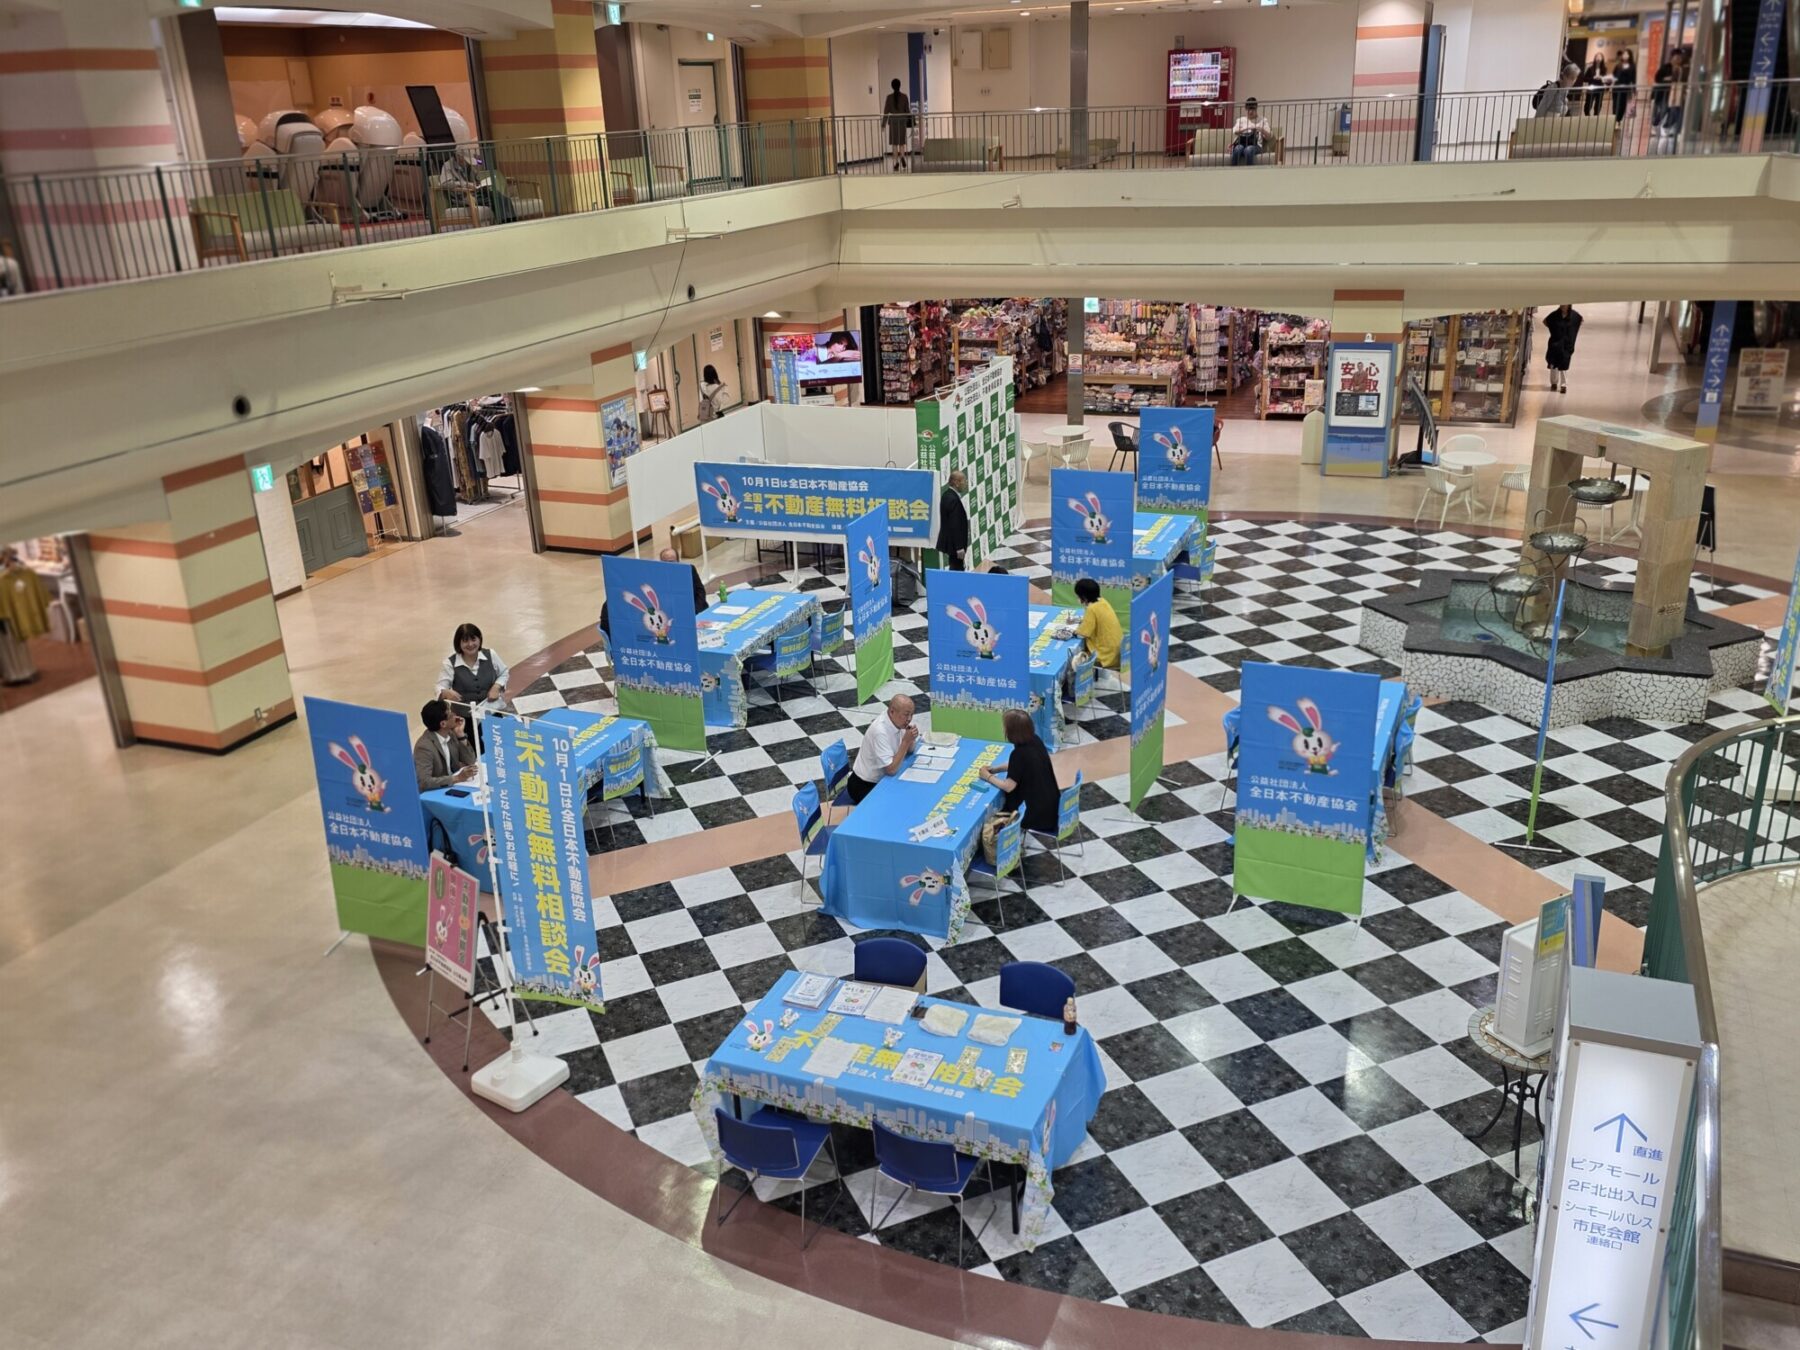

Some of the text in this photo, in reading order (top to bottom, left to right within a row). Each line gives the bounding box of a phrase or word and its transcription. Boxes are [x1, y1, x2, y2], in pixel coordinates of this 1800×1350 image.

[1341, 362, 1379, 376] 安心
[742, 476, 869, 492] 10月1日は全日本不動産協会
[1060, 554, 1125, 568] 全日本不動産協会
[621, 655, 692, 673] 全日本不動産協会
[936, 662, 980, 674] 公益社団法人
[936, 671, 1017, 689] 全日本不動産協会
[1249, 775, 1308, 791] 公益社団法人
[1249, 786, 1358, 812] 全日本不動産協会
[329, 822, 413, 848] 全日本不動産協会
[552, 737, 587, 923] 10月1日は全日本不動産協会
[515, 741, 571, 977] 不動産無料相談会
[1633, 1145, 1663, 1162] 直進
[1571, 1157, 1660, 1185] ピアモール
[1568, 1179, 1657, 1208] 2F北出入口
[1573, 1218, 1641, 1244] 市民会館
[1586, 1235, 1623, 1251] 連絡口
